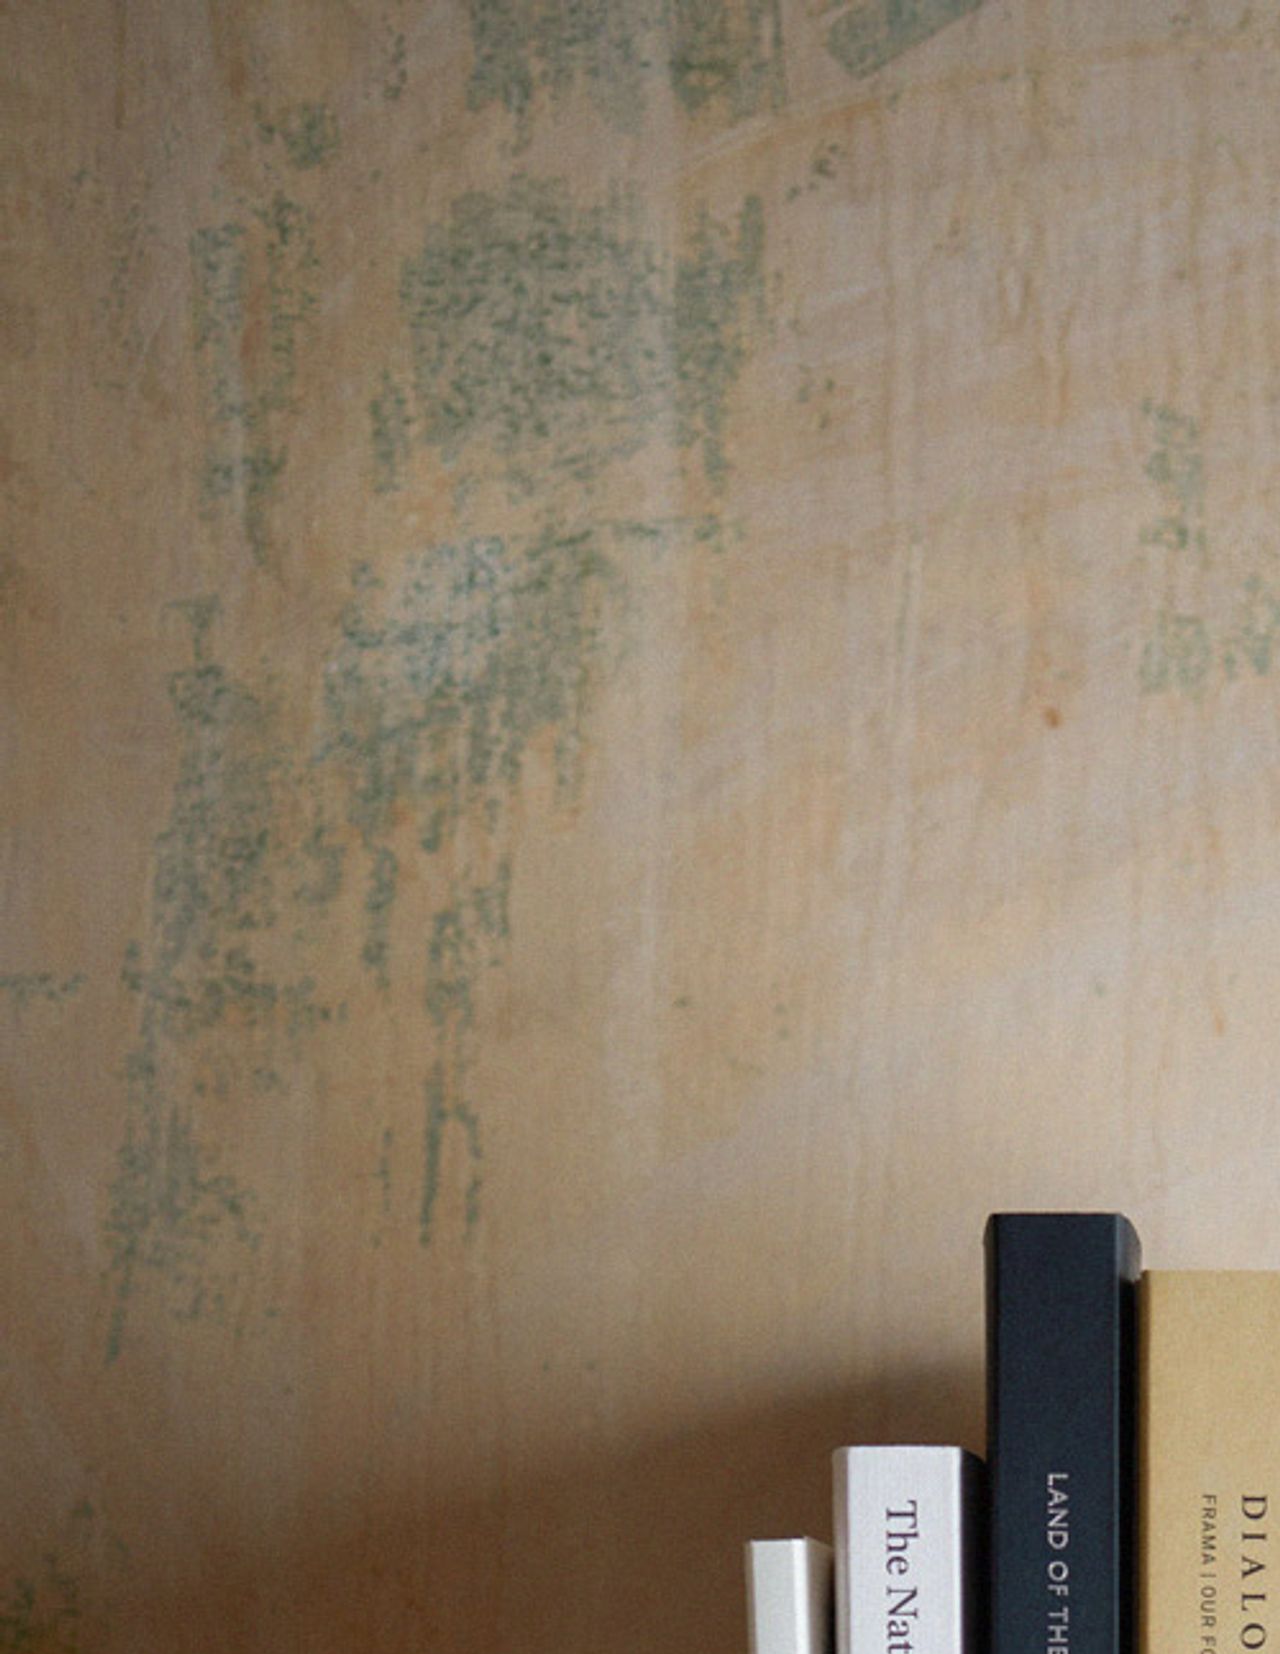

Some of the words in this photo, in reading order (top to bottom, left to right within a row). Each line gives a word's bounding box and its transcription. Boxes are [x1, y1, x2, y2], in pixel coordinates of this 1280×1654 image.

[885, 1499, 920, 1576] The
[1047, 1473, 1069, 1550] LAND
[1201, 1493, 1218, 1565] FRAMA
[1047, 1560, 1069, 1596] OF
[1199, 1585, 1217, 1629] OUR
